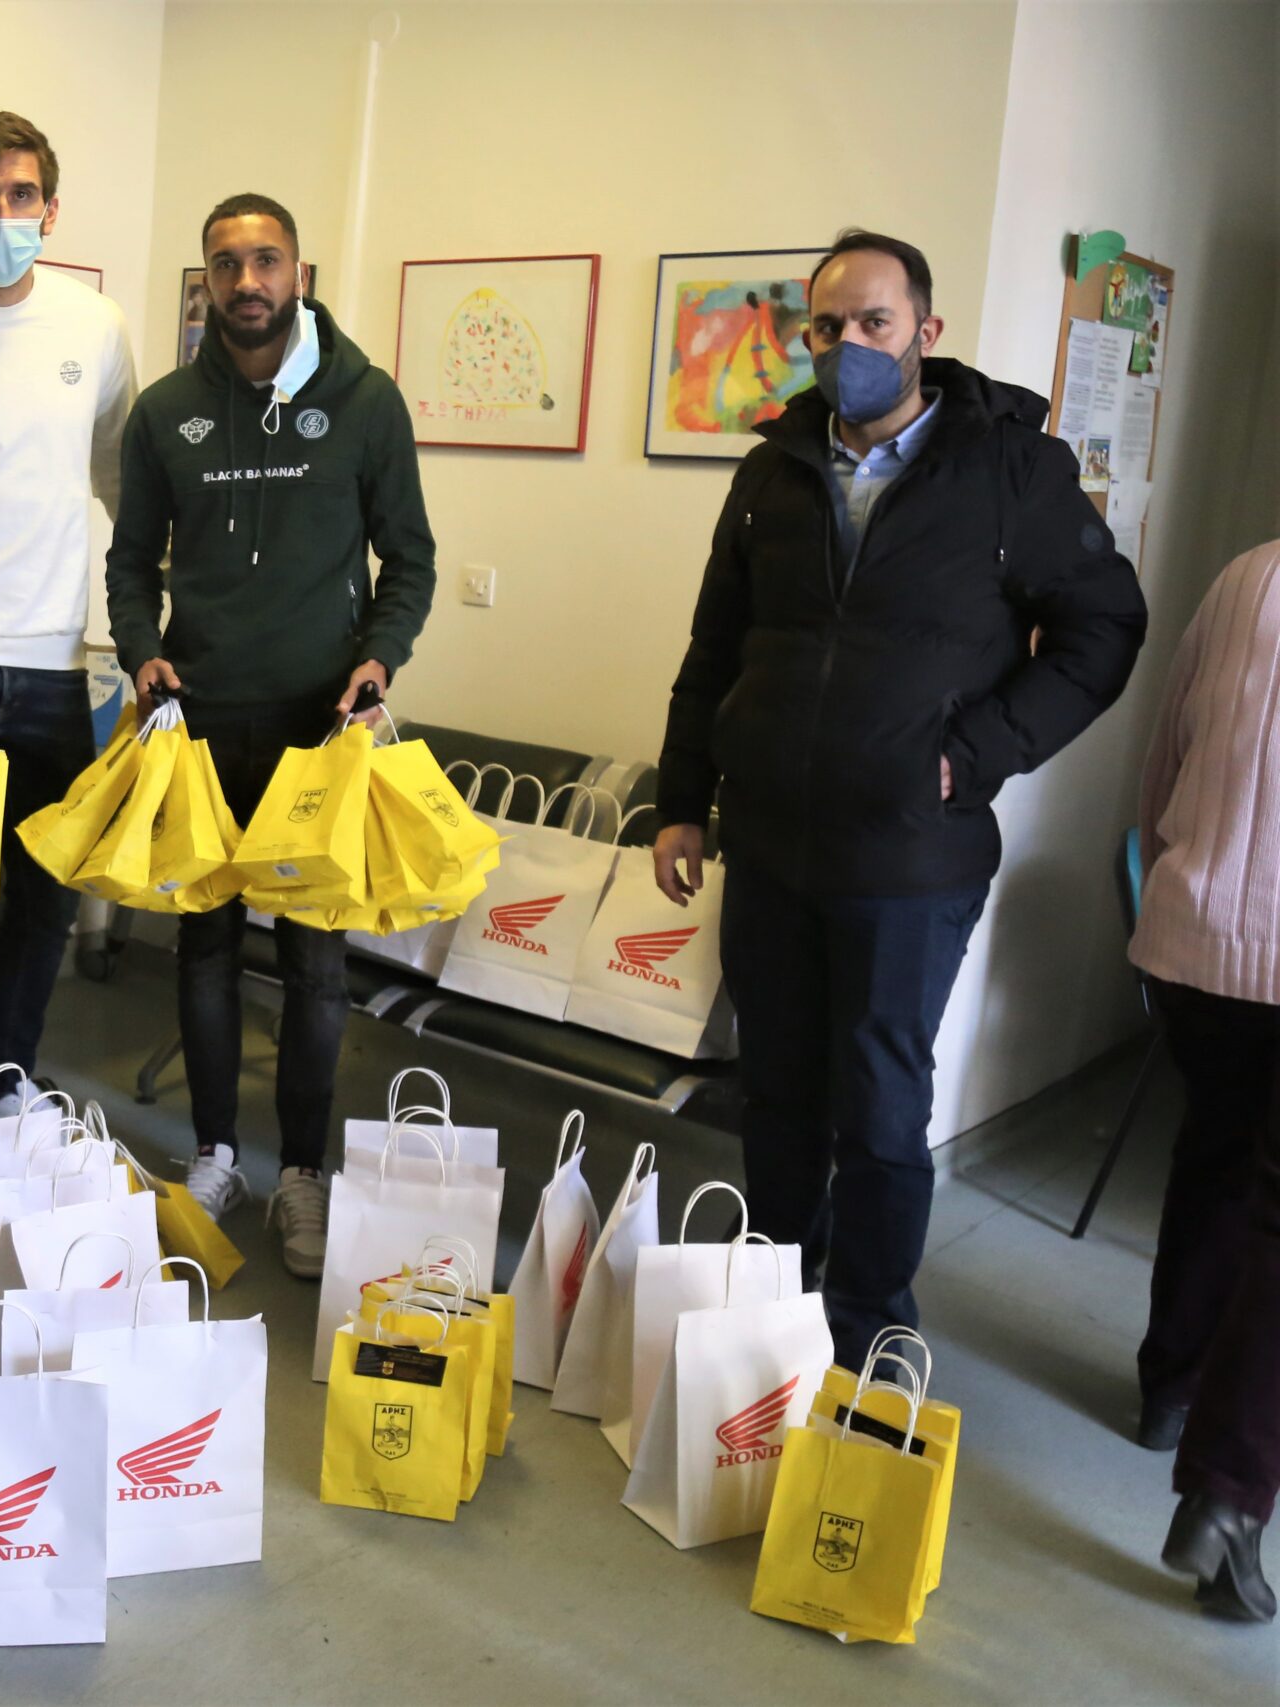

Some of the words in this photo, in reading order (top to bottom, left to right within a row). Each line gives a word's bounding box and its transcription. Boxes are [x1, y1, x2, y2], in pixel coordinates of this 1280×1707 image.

[203, 470, 243, 483] BLACK
[482, 928, 549, 955] HONDA
[606, 960, 682, 991] HONDA
[716, 1444, 784, 1469] HOND
[117, 1480, 224, 1502] HONDA
